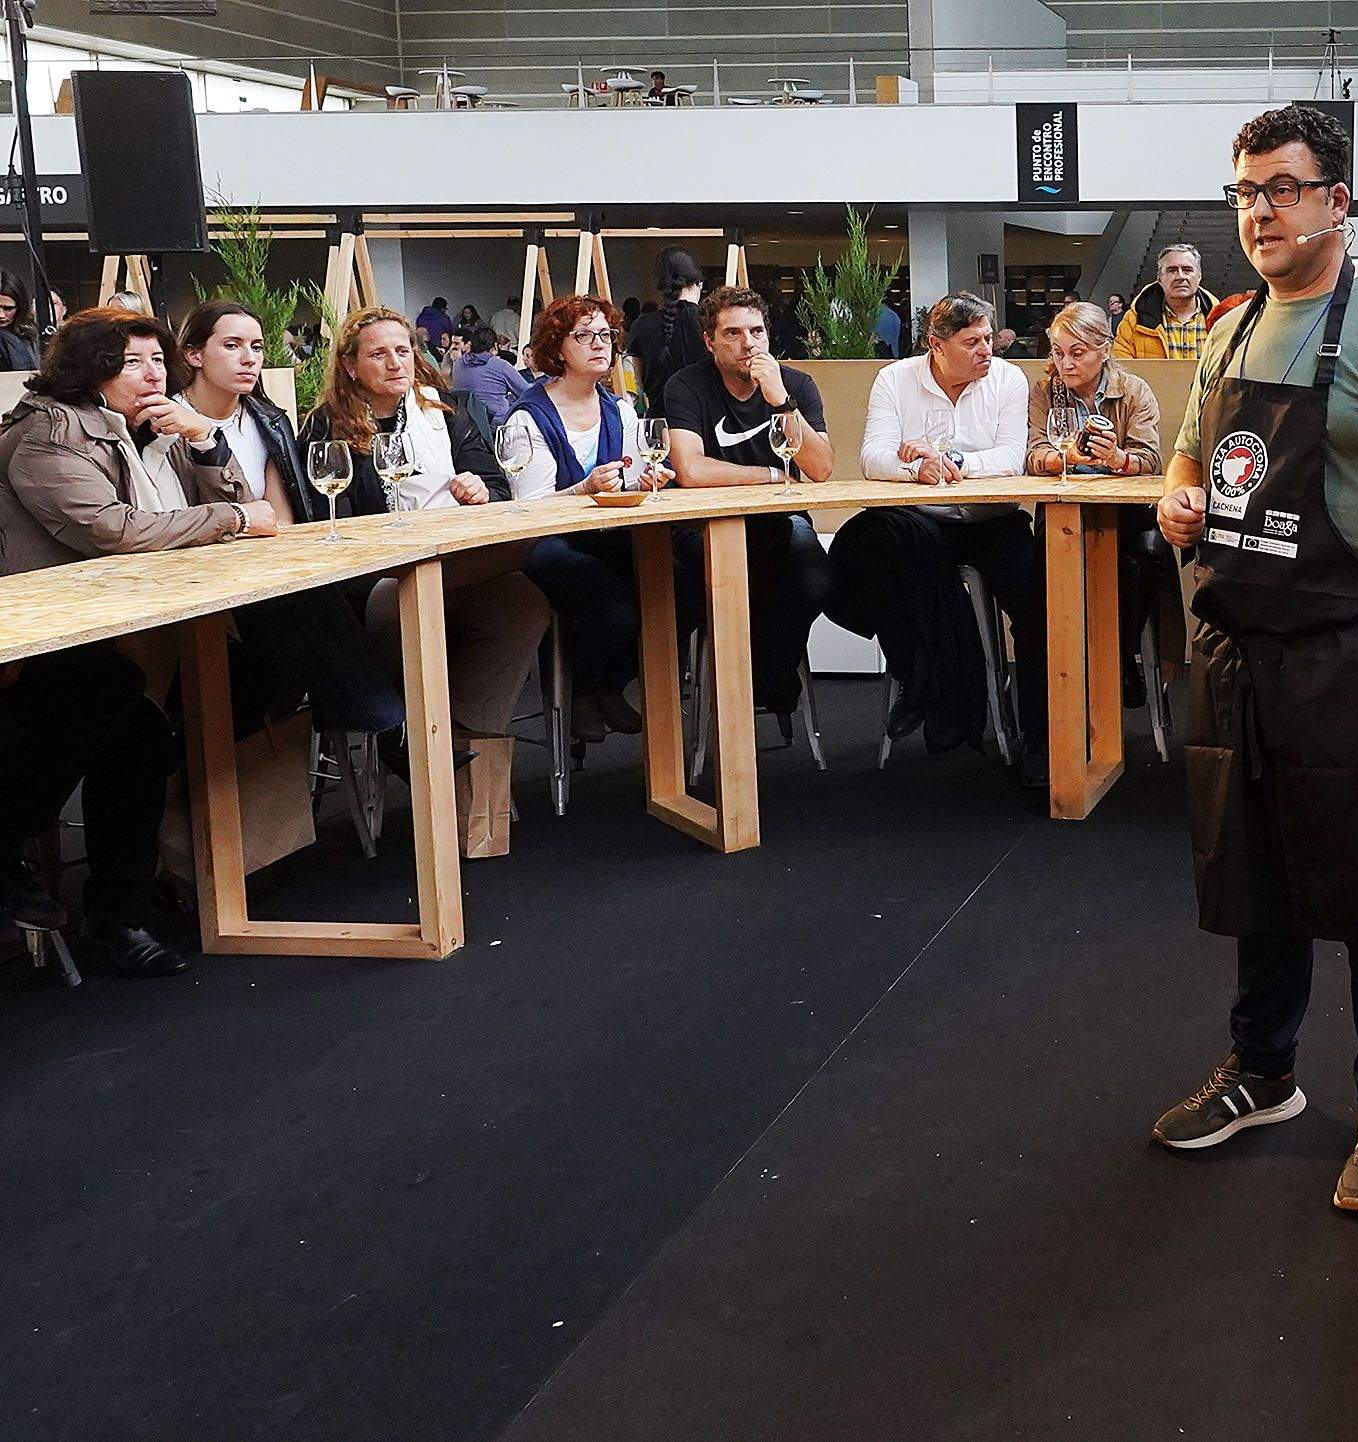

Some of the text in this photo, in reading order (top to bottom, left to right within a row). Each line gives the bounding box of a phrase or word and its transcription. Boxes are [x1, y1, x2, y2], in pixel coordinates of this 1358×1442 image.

[1031, 129, 1043, 181] PUNTO de
[1042, 122, 1053, 181] ENCONTRO
[1053, 110, 1064, 181] PROFESIONAL
[1213, 447, 1228, 476] RAZA
[1220, 483, 1246, 497] 100%
[1212, 501, 1242, 514] CACHENA
[1263, 515, 1298, 537] Boaga
